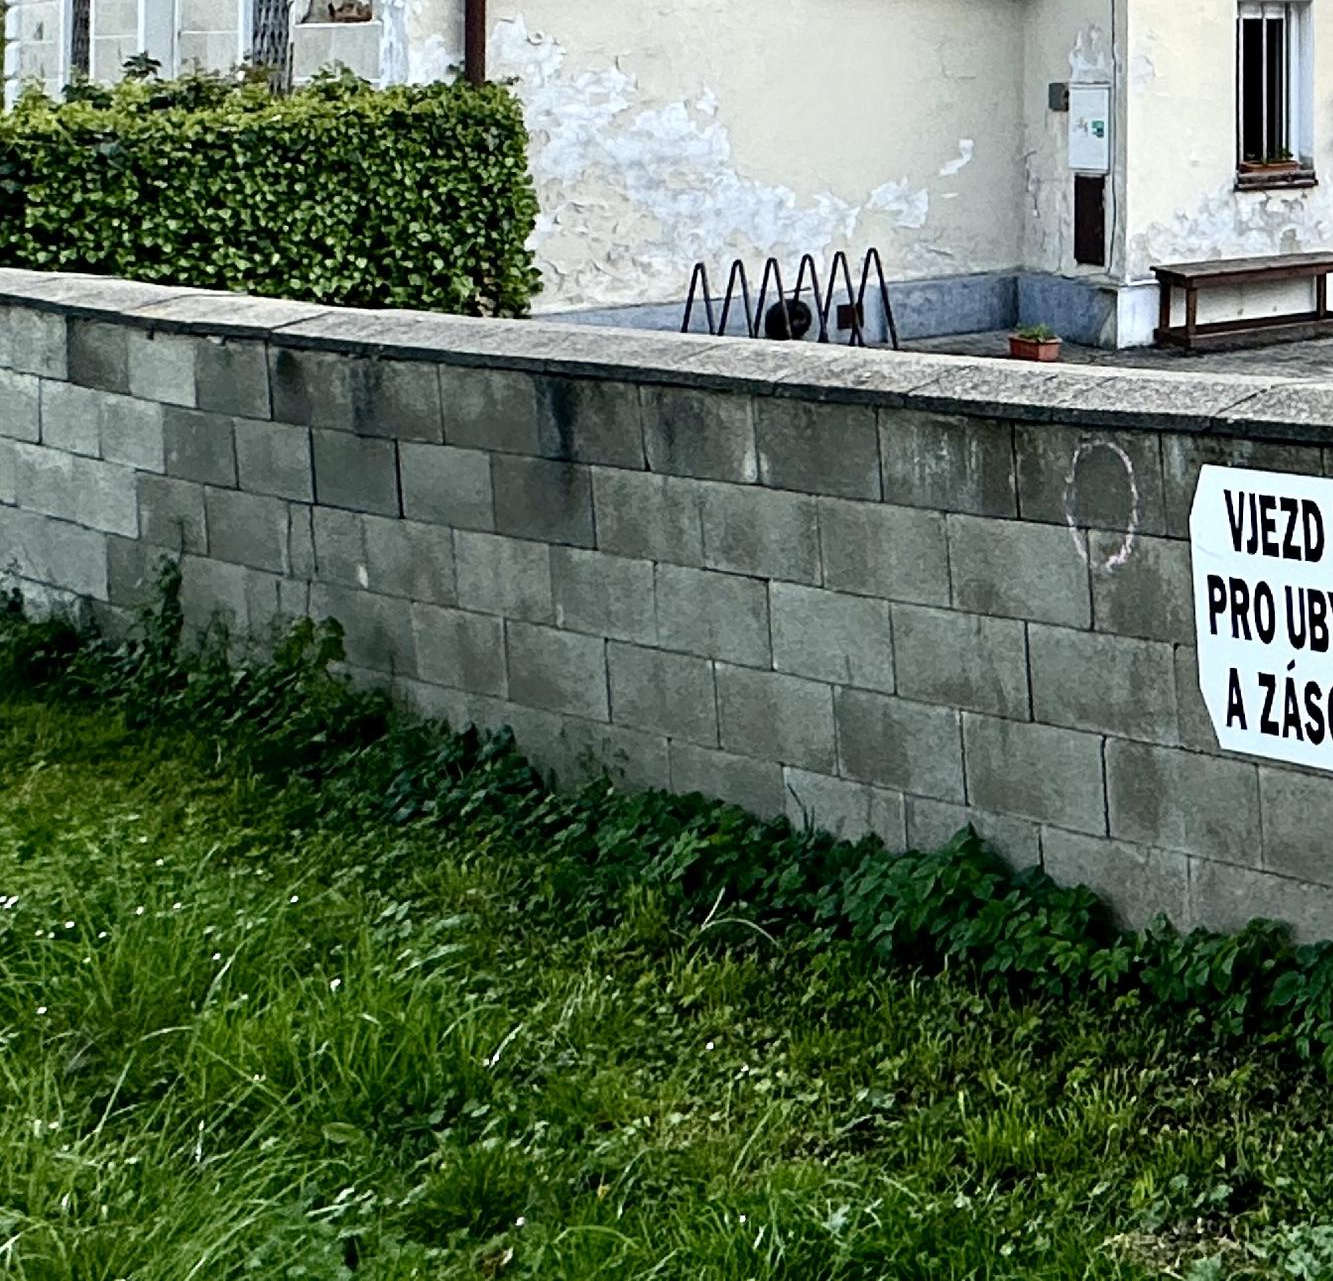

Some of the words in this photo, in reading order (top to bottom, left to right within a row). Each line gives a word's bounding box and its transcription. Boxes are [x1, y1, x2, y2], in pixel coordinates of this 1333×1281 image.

[1223, 489, 1325, 563] VJEZD
[1206, 574, 1276, 645] PRO
[1226, 667, 1248, 731] A
